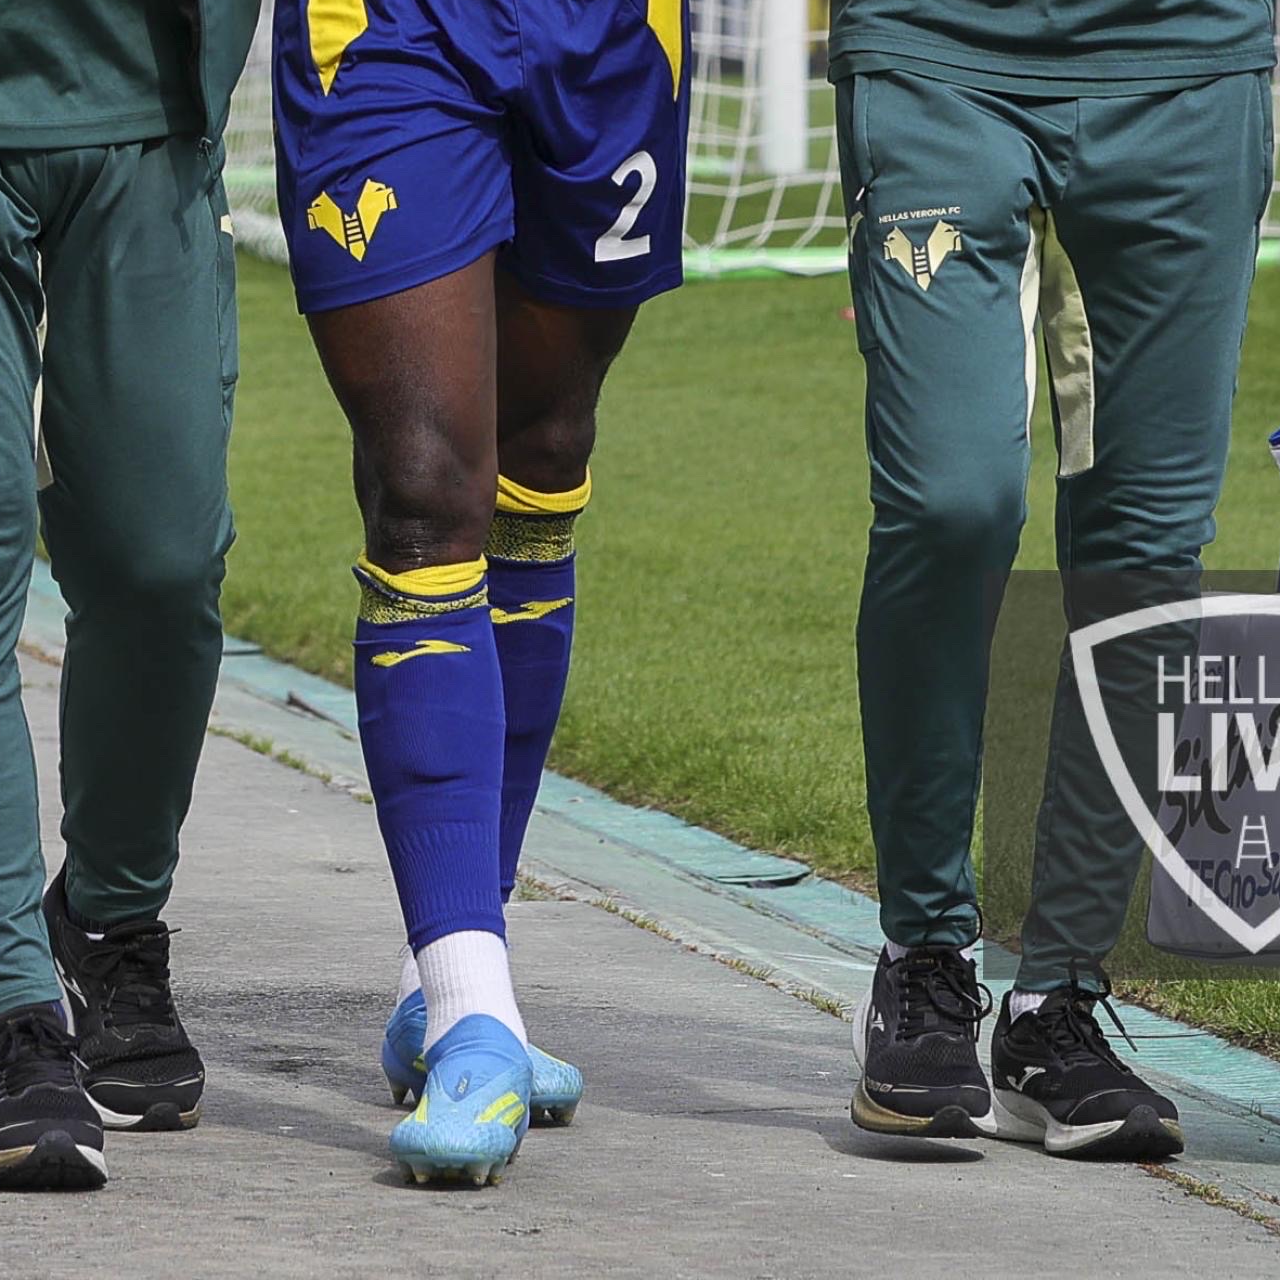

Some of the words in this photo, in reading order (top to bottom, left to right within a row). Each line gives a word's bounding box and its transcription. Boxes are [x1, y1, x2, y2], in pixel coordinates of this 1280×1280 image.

[594, 150, 658, 262] 2
[878, 211, 909, 224] HELLAS
[910, 207, 948, 219] VERONA
[948, 206, 961, 215] FC
